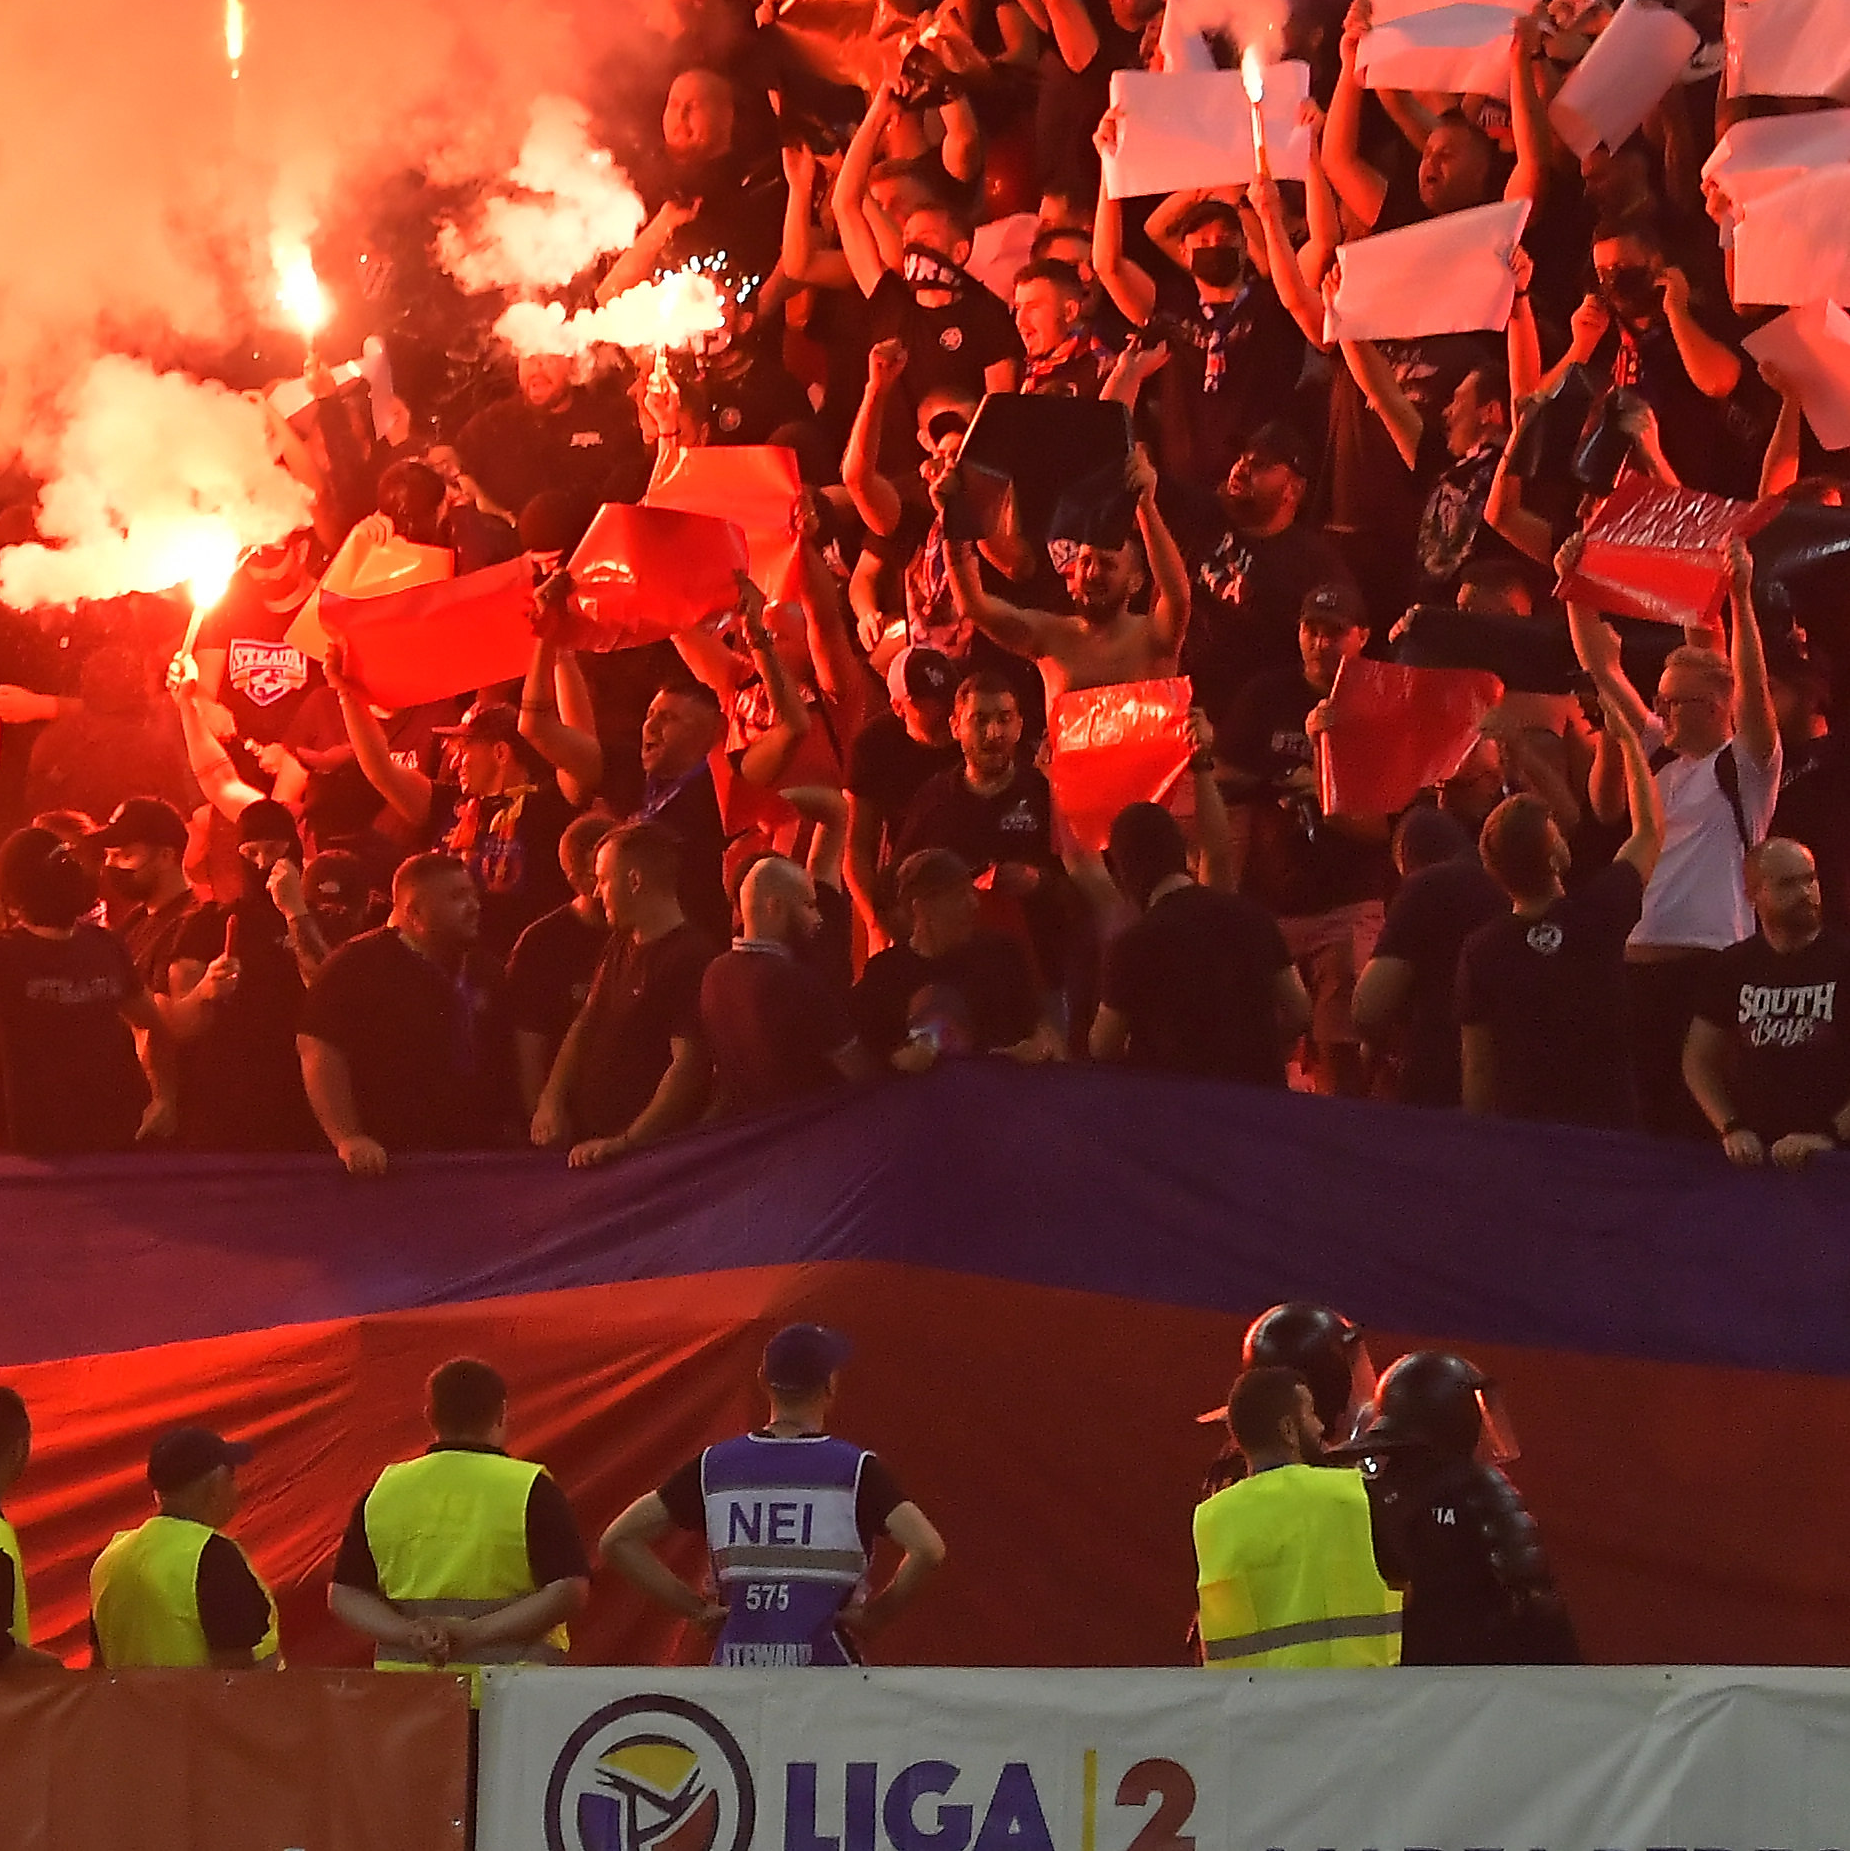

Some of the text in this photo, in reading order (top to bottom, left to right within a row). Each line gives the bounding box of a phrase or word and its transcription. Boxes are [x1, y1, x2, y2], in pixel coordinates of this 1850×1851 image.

[1738, 981, 1836, 1024] SOUTH
[728, 1501, 813, 1546] NEI
[746, 1584, 789, 1611] 575
[784, 1757, 1197, 1851] LIGA 2
